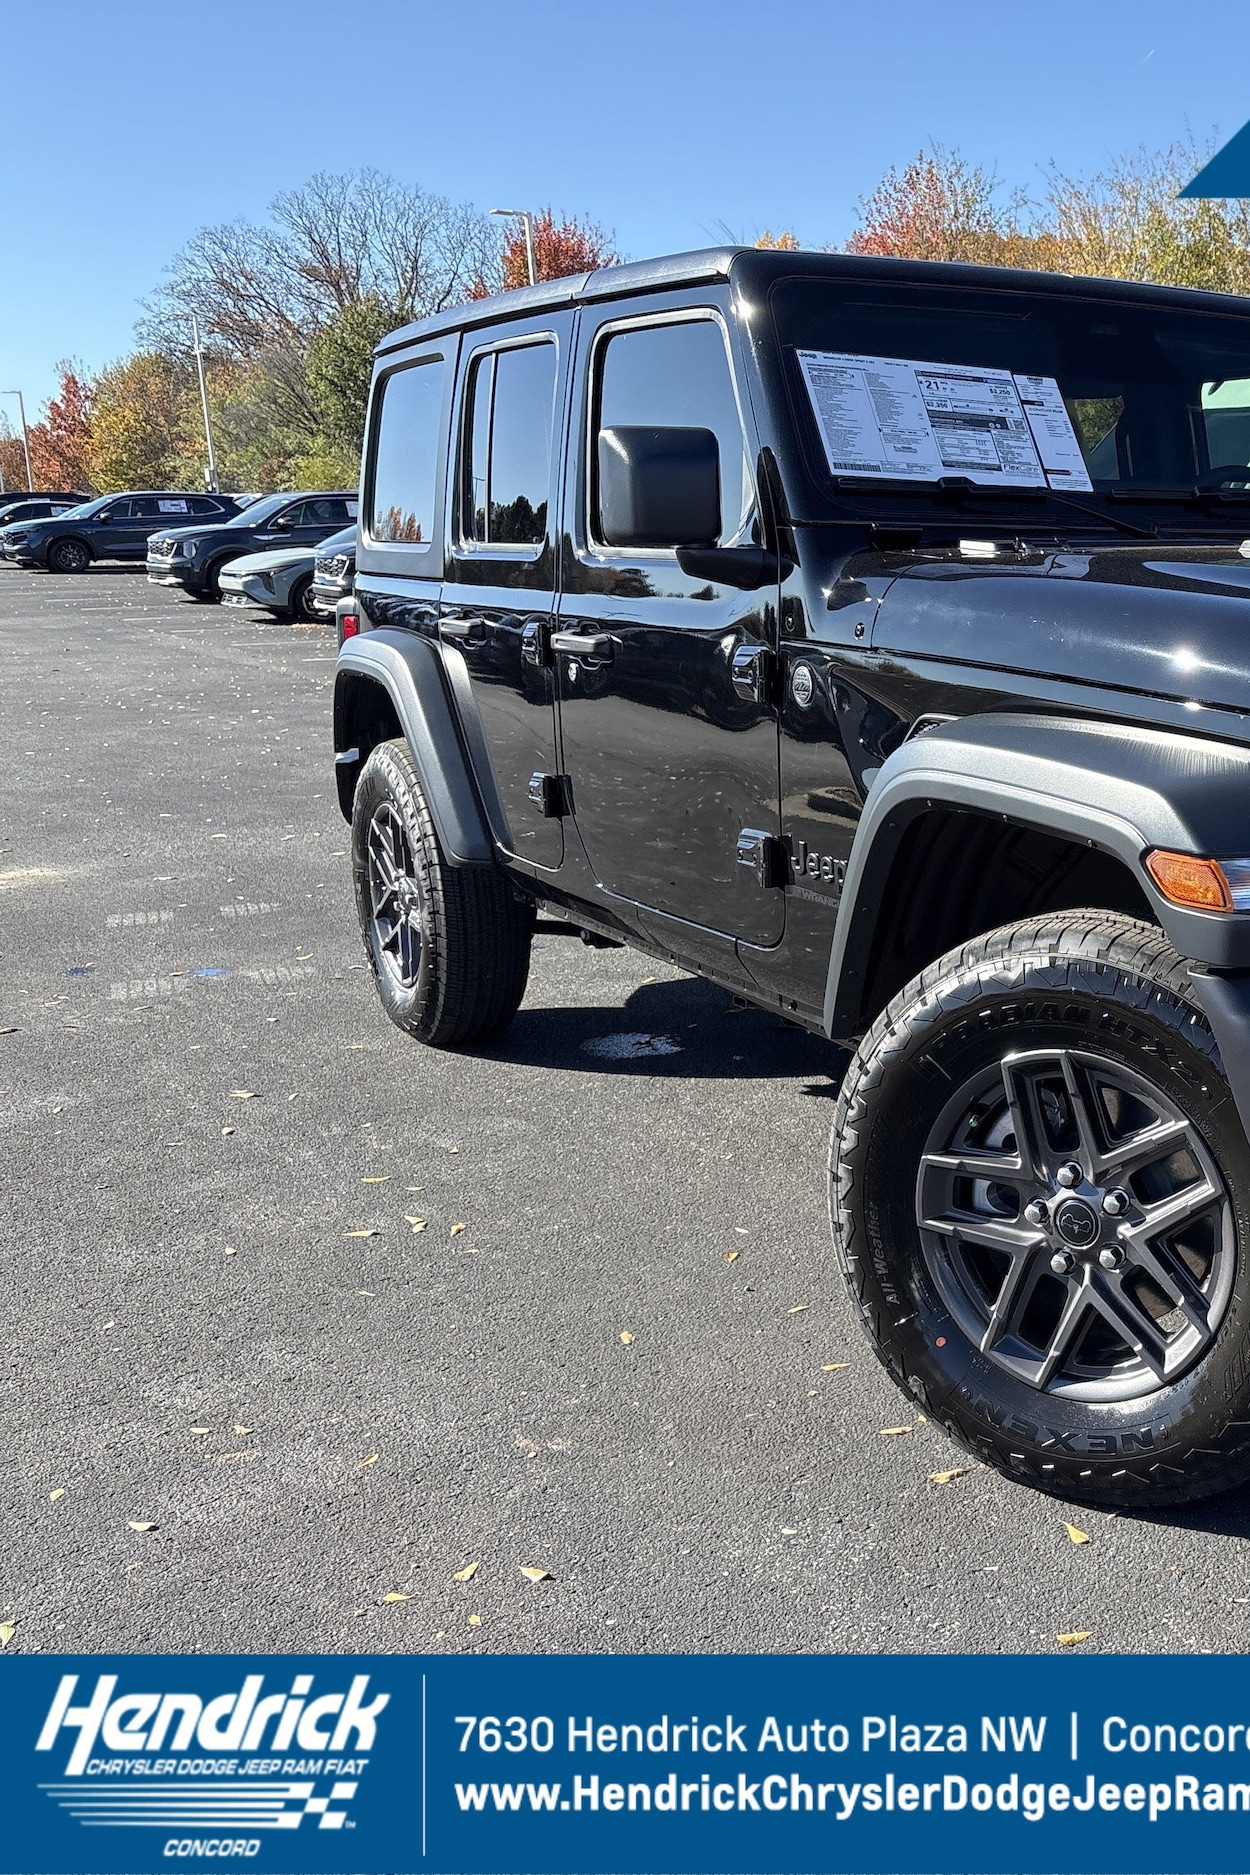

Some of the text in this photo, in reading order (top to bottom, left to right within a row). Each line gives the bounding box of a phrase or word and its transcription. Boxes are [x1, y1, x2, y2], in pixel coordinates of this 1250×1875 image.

[924, 380, 940, 390] 21
[867, 1200, 901, 1306] All-Weather
[971, 1393, 1155, 1455] NEXEN
